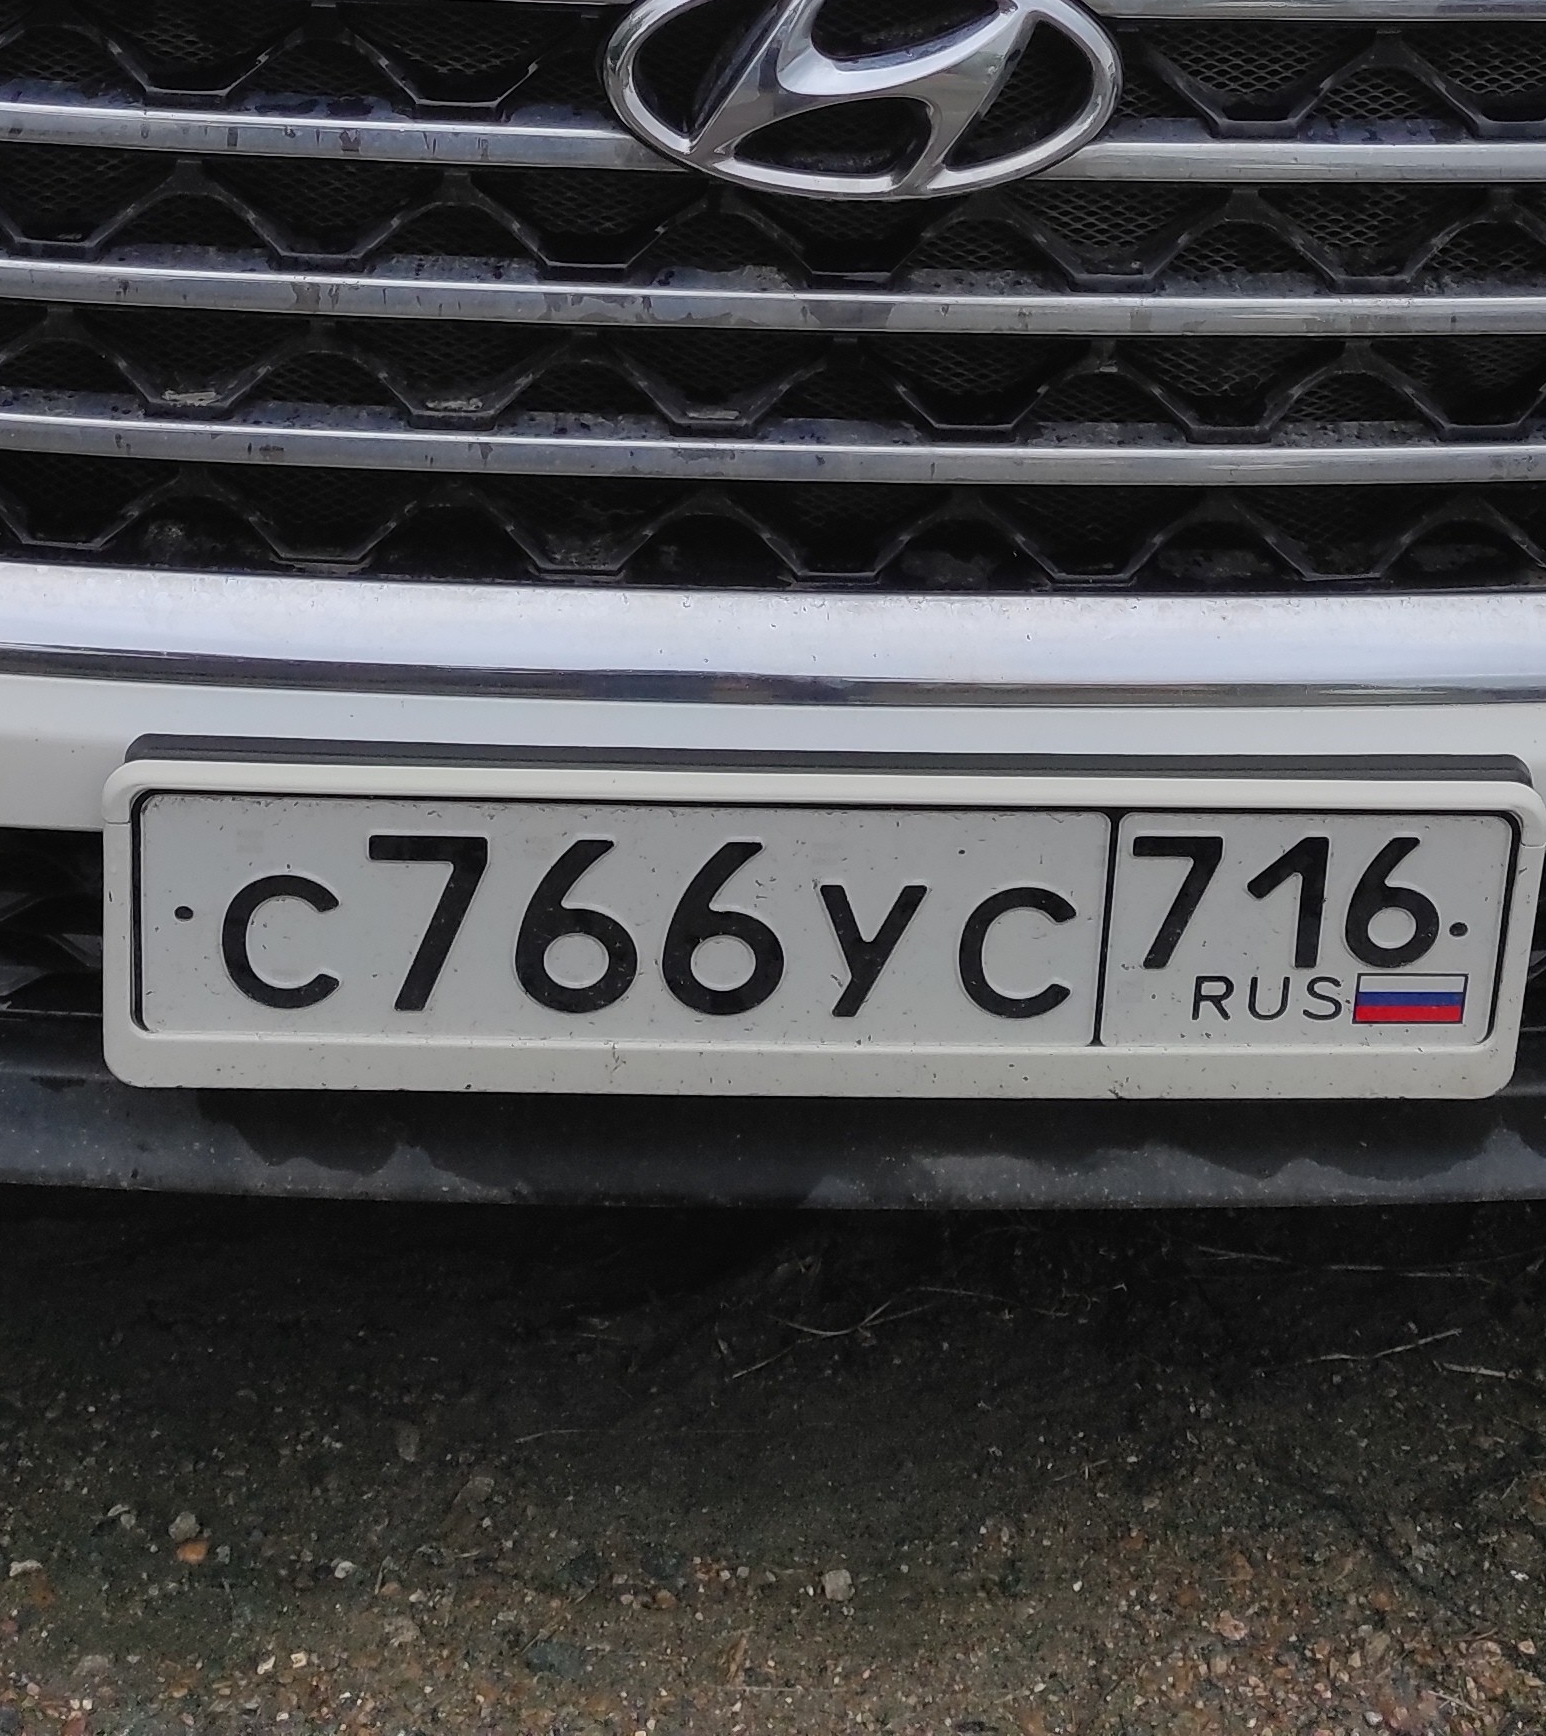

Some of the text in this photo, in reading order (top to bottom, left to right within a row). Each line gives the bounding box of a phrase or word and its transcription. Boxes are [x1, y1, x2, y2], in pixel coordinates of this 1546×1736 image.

[218, 833, 1441, 1020] С766УС 716
[1190, 975, 1344, 1022] RUS
